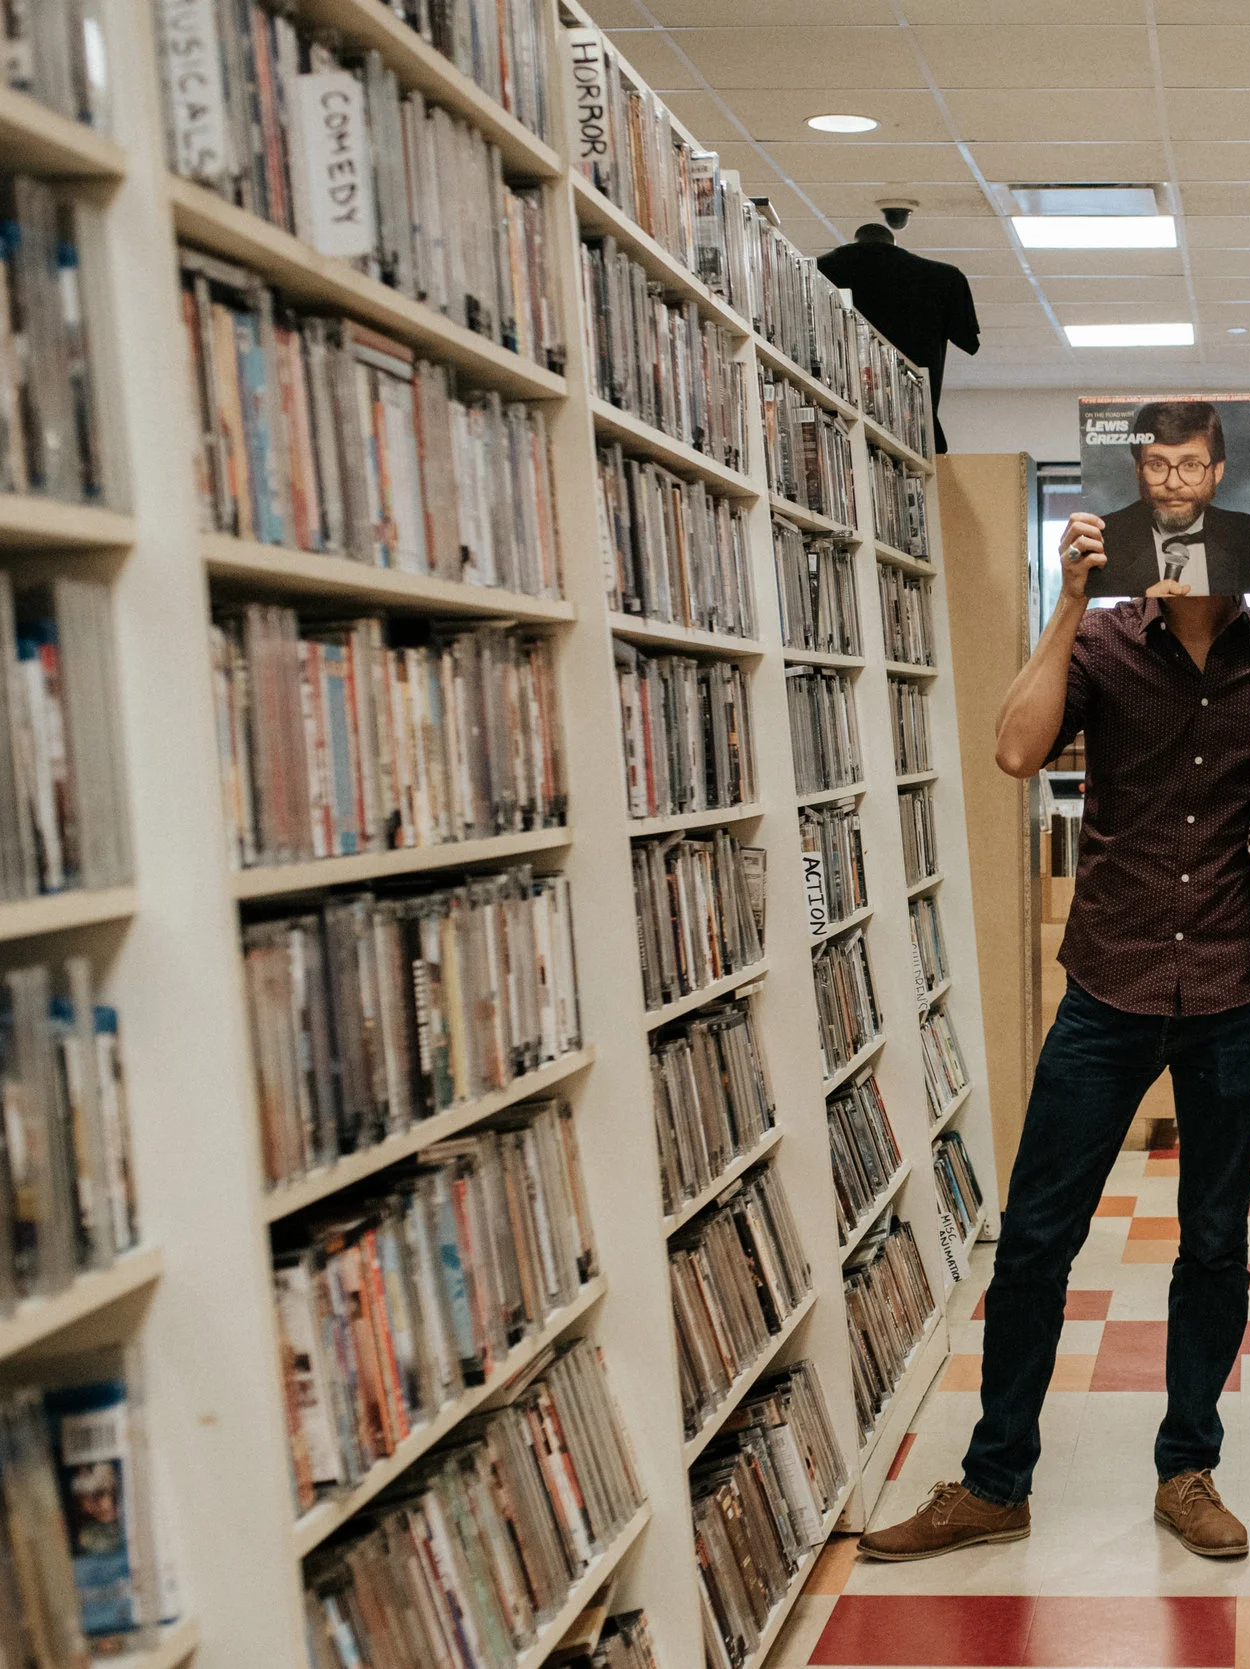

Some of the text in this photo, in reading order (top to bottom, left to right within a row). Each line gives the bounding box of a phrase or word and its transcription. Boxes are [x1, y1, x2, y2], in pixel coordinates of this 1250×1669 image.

[170, 0, 217, 171] USICALS
[571, 42, 608, 158] HORROR
[320, 90, 361, 224] COMEDY
[1086, 419, 1129, 432] LEWIS
[1086, 432, 1155, 445] GRIZZARD
[802, 856, 828, 936] ACTION
[939, 1230, 963, 1283] ANIMATION
